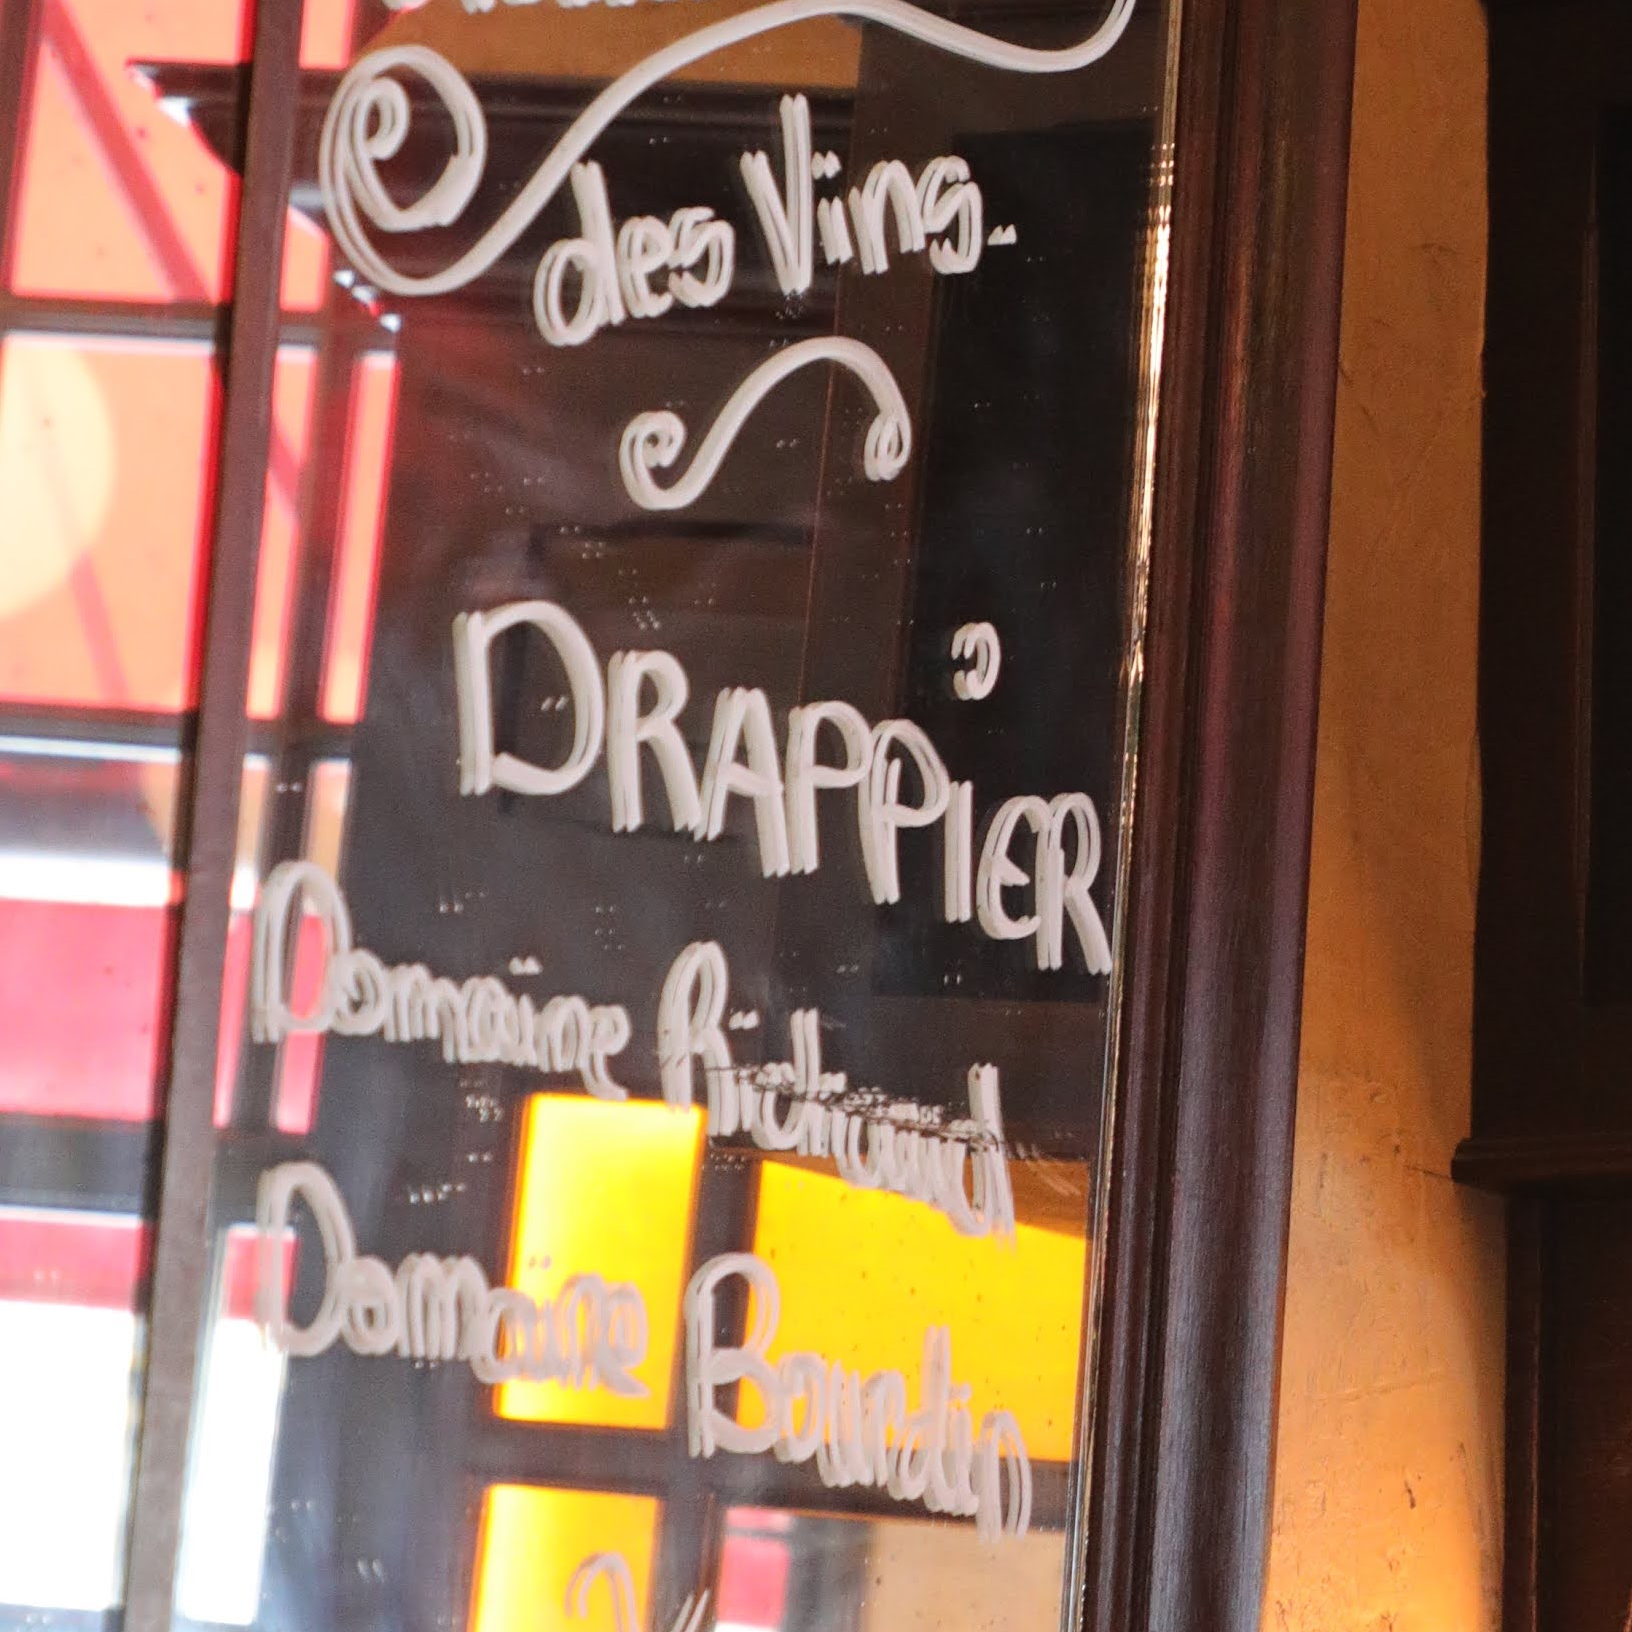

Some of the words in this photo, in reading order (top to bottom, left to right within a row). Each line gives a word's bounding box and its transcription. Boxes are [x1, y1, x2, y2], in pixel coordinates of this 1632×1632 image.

[534, 160, 734, 347] des
[250, 858, 630, 1102] Domaine
[255, 1161, 650, 1399] Domaine
